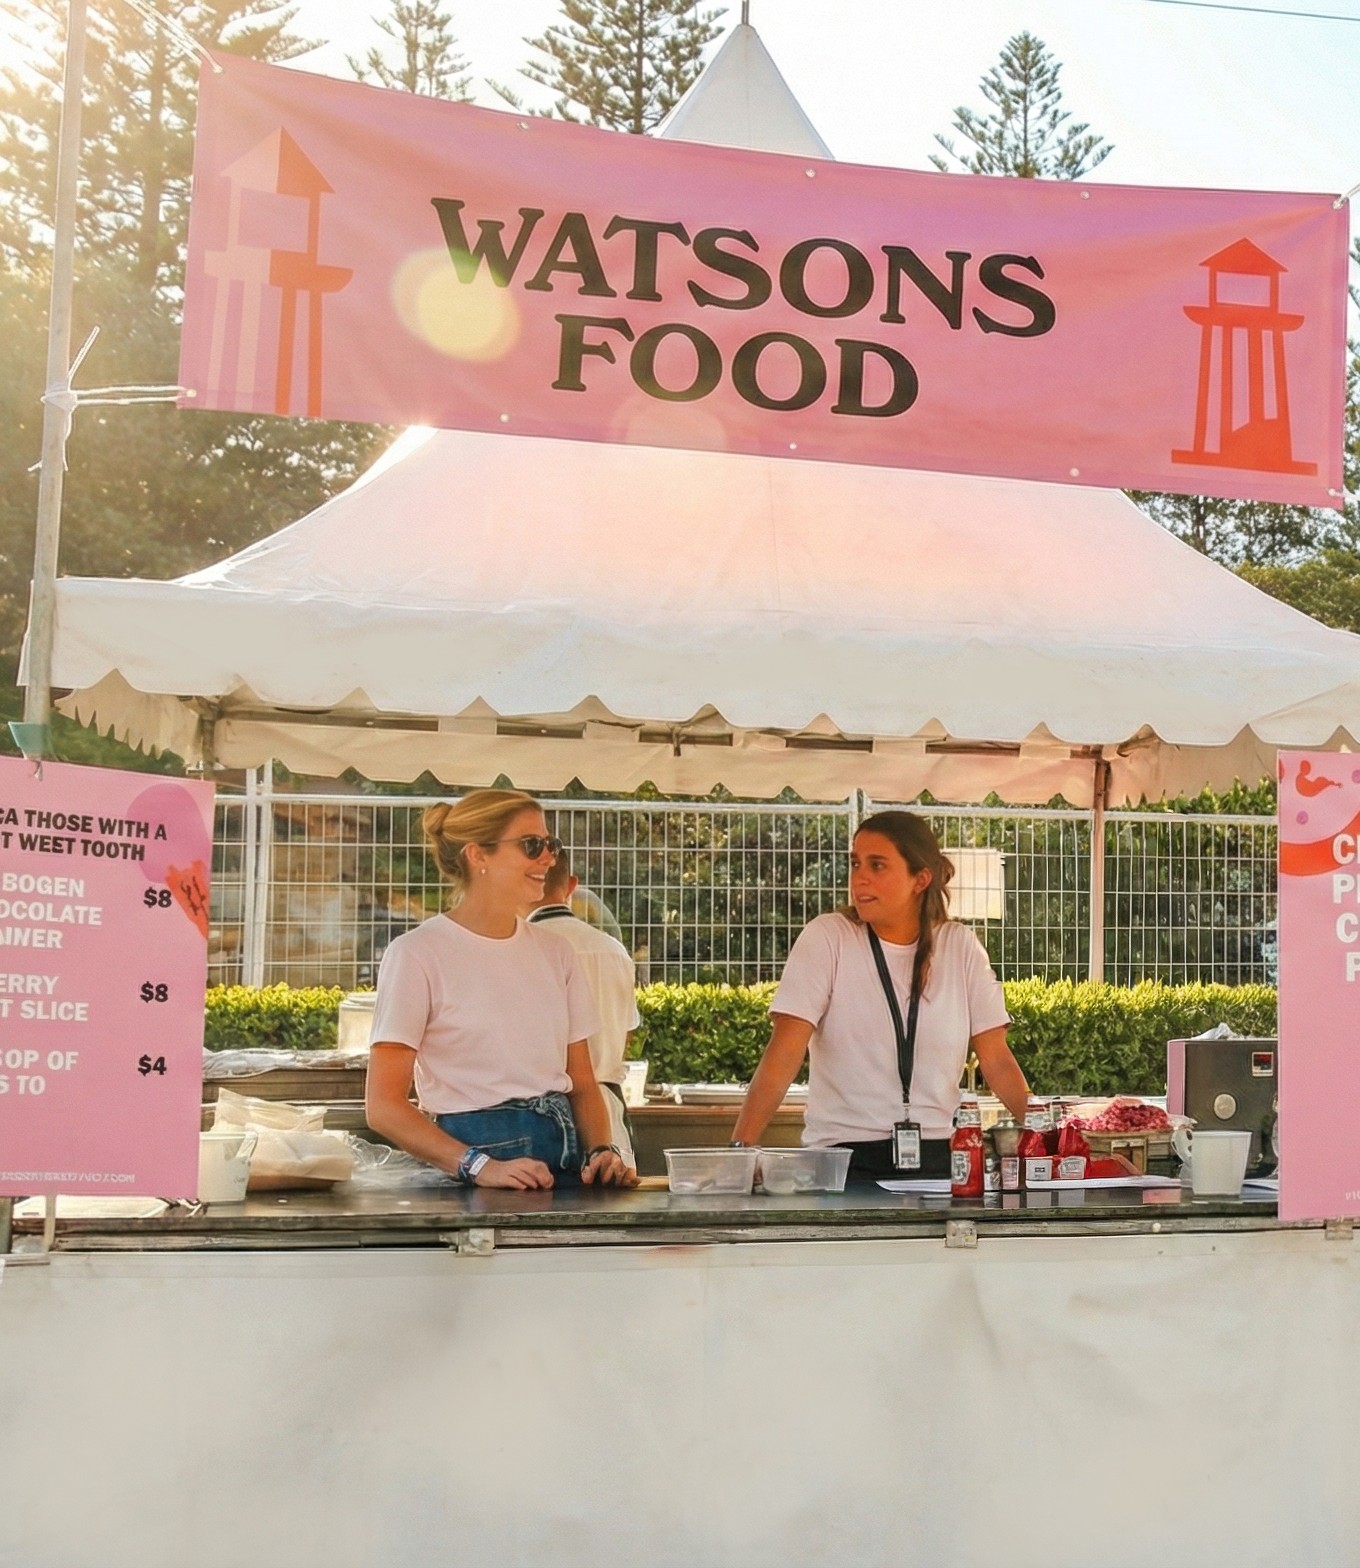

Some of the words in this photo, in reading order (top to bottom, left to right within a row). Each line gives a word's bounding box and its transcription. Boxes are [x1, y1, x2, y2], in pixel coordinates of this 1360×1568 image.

[431, 197, 1056, 338] WATSONS
[551, 314, 918, 417] FOOD
[24, 809, 92, 833] THOSE
[99, 819, 149, 839] WITH
[154, 824, 168, 841] A
[19, 833, 76, 854] WEET
[81, 839, 145, 861] TOOTH
[143, 887, 172, 908] $8
[140, 981, 168, 1003] $8
[20, 1000, 89, 1021] SLICE
[0, 1048, 39, 1070] OP
[47, 1050, 79, 1071] OF
[138, 1054, 167, 1076] $4
[16, 1075, 46, 1096] TO
